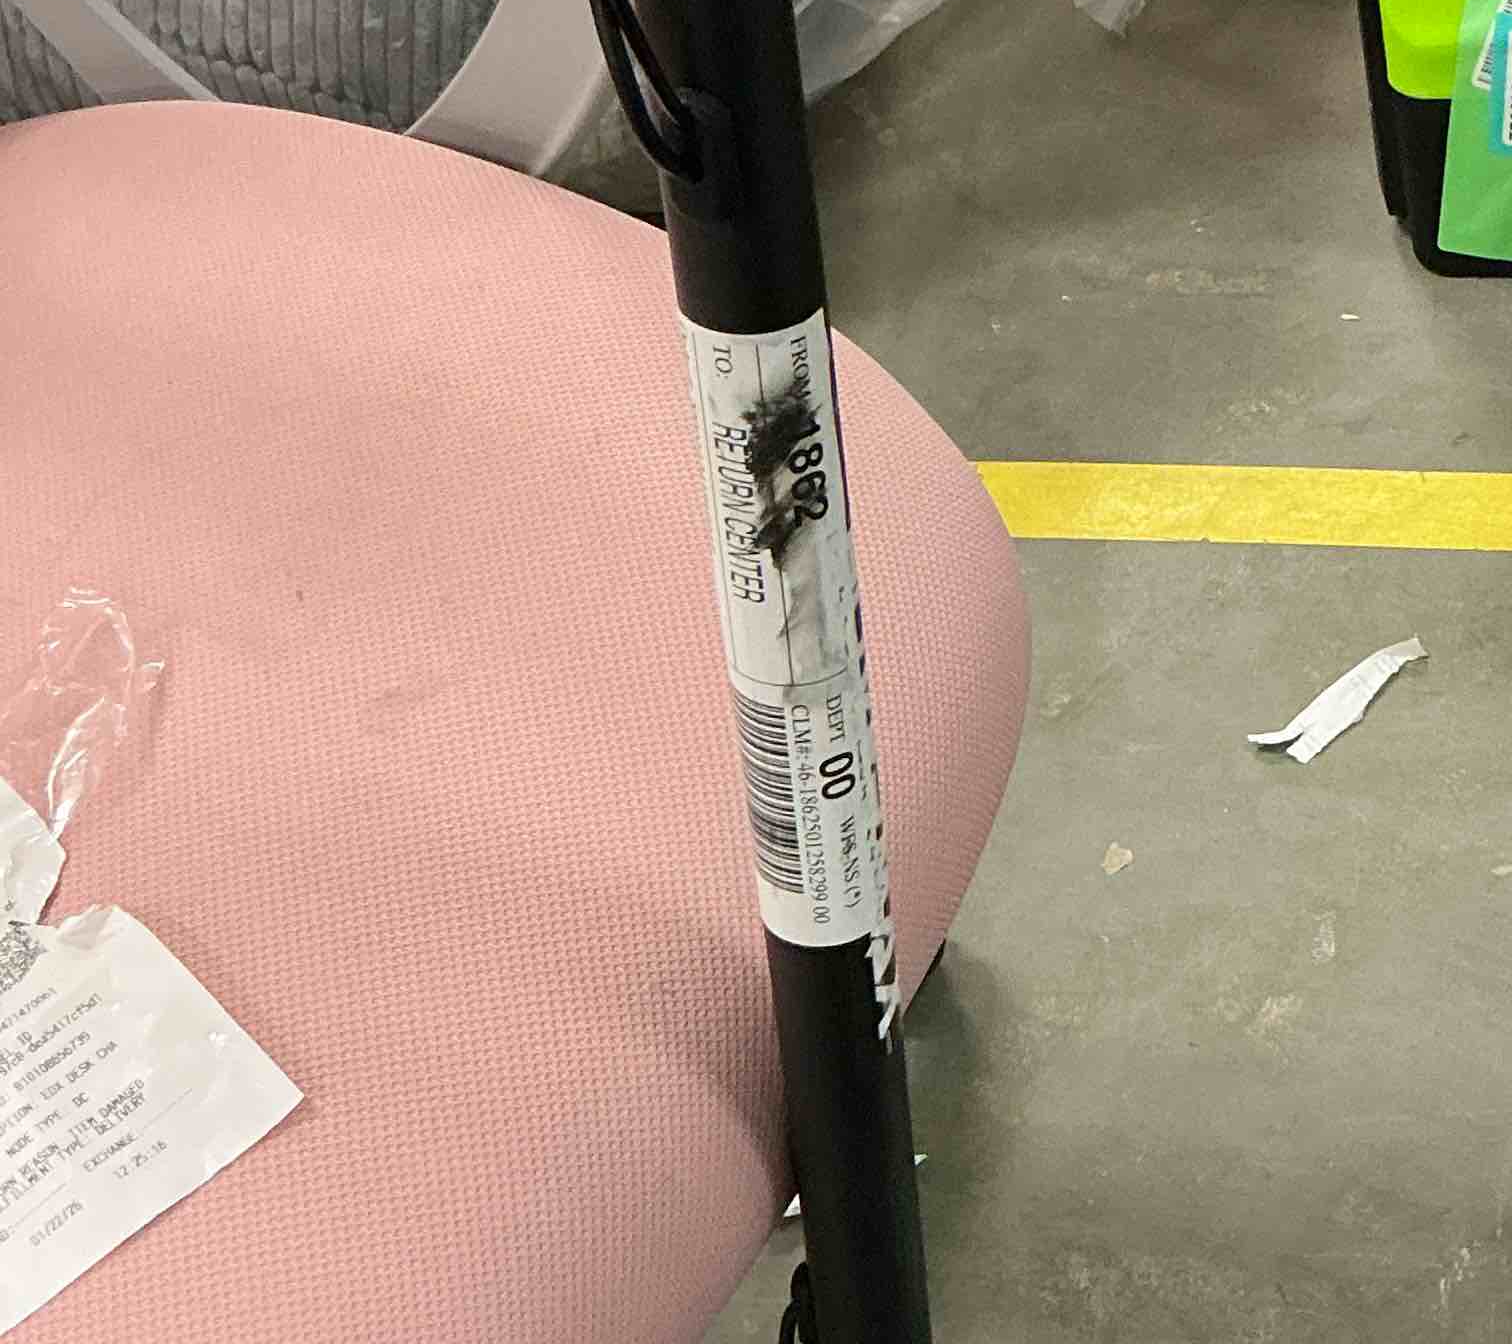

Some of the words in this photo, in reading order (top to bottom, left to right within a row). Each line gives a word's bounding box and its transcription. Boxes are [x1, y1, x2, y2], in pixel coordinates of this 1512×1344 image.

[713, 344, 734, 378] TO:
[789, 335, 813, 401] FROM
[712, 422, 754, 514] RETURN
[724, 517, 765, 604] CENTER
[825, 693, 846, 743] DEPT
[818, 750, 856, 800] 00
